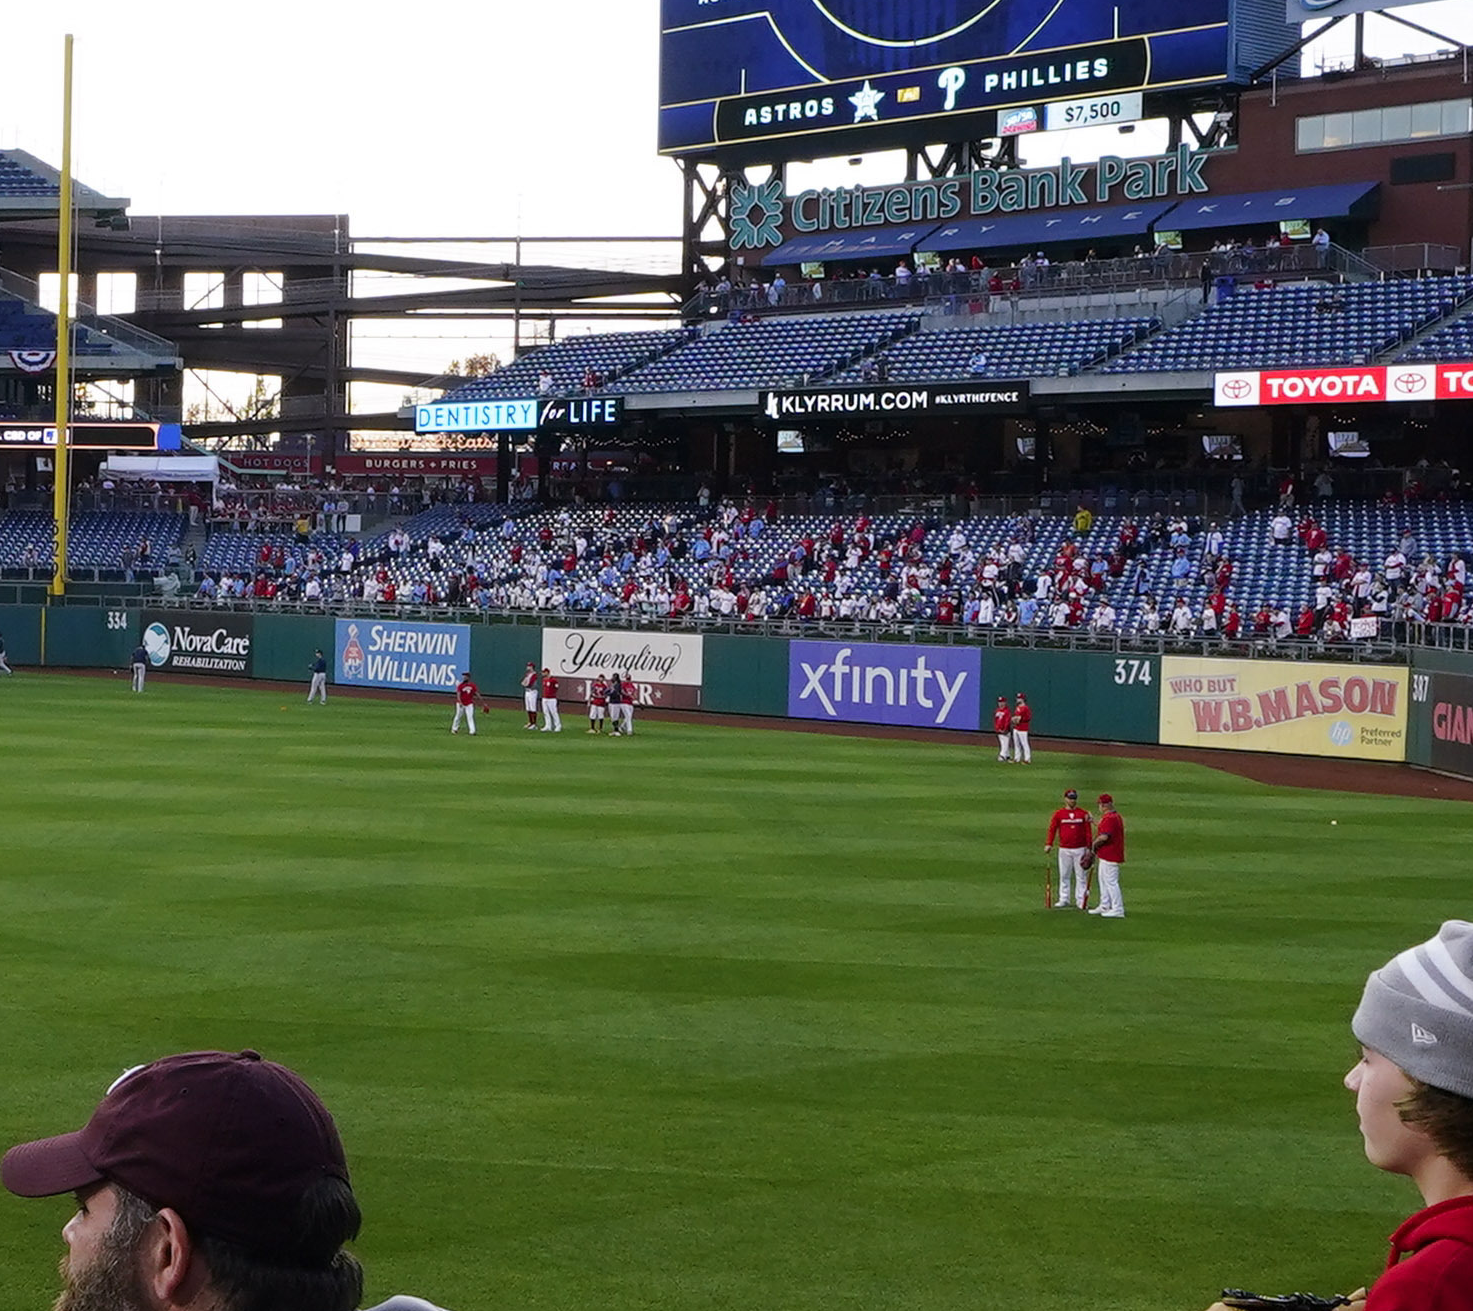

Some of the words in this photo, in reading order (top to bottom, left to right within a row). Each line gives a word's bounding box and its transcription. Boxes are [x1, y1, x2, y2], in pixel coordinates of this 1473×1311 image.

[985, 58, 1108, 92] PHILLIES
[744, 97, 834, 126] ASTROS
[1064, 100, 1121, 124] $7,500
[791, 180, 962, 232] Citizens
[970, 156, 1089, 215] Bank
[1096, 142, 1209, 203] Park
[1046, 211, 1143, 227] THE
[1266, 374, 1379, 397] TOYOTA
[419, 404, 532, 427] DENTISTRY
[540, 401, 565, 425] for
[569, 400, 616, 423] LIFE
[782, 391, 928, 413] KLYRRUM.COM
[27, 430, 41, 441] OF
[243, 458, 270, 467] HOT
[273, 458, 309, 467] DOGS
[366, 458, 425, 469] BURGERS
[441, 459, 477, 470] FRIES
[107, 611, 127, 630] 334
[172, 626, 250, 655] NovaCare
[368, 624, 457, 656] SHERWIN
[172, 656, 246, 671] REHABILITATION
[560, 632, 683, 681] Yuengling
[1114, 658, 1152, 686] 374
[584, 679, 655, 706] LER
[799, 648, 968, 724] xfinity
[1169, 677, 1204, 694] WHO
[1207, 677, 1237, 693] BUT
[1331, 723, 1352, 745] hp
[1360, 727, 1402, 738] Preferred
[1360, 735, 1393, 746] Partner
